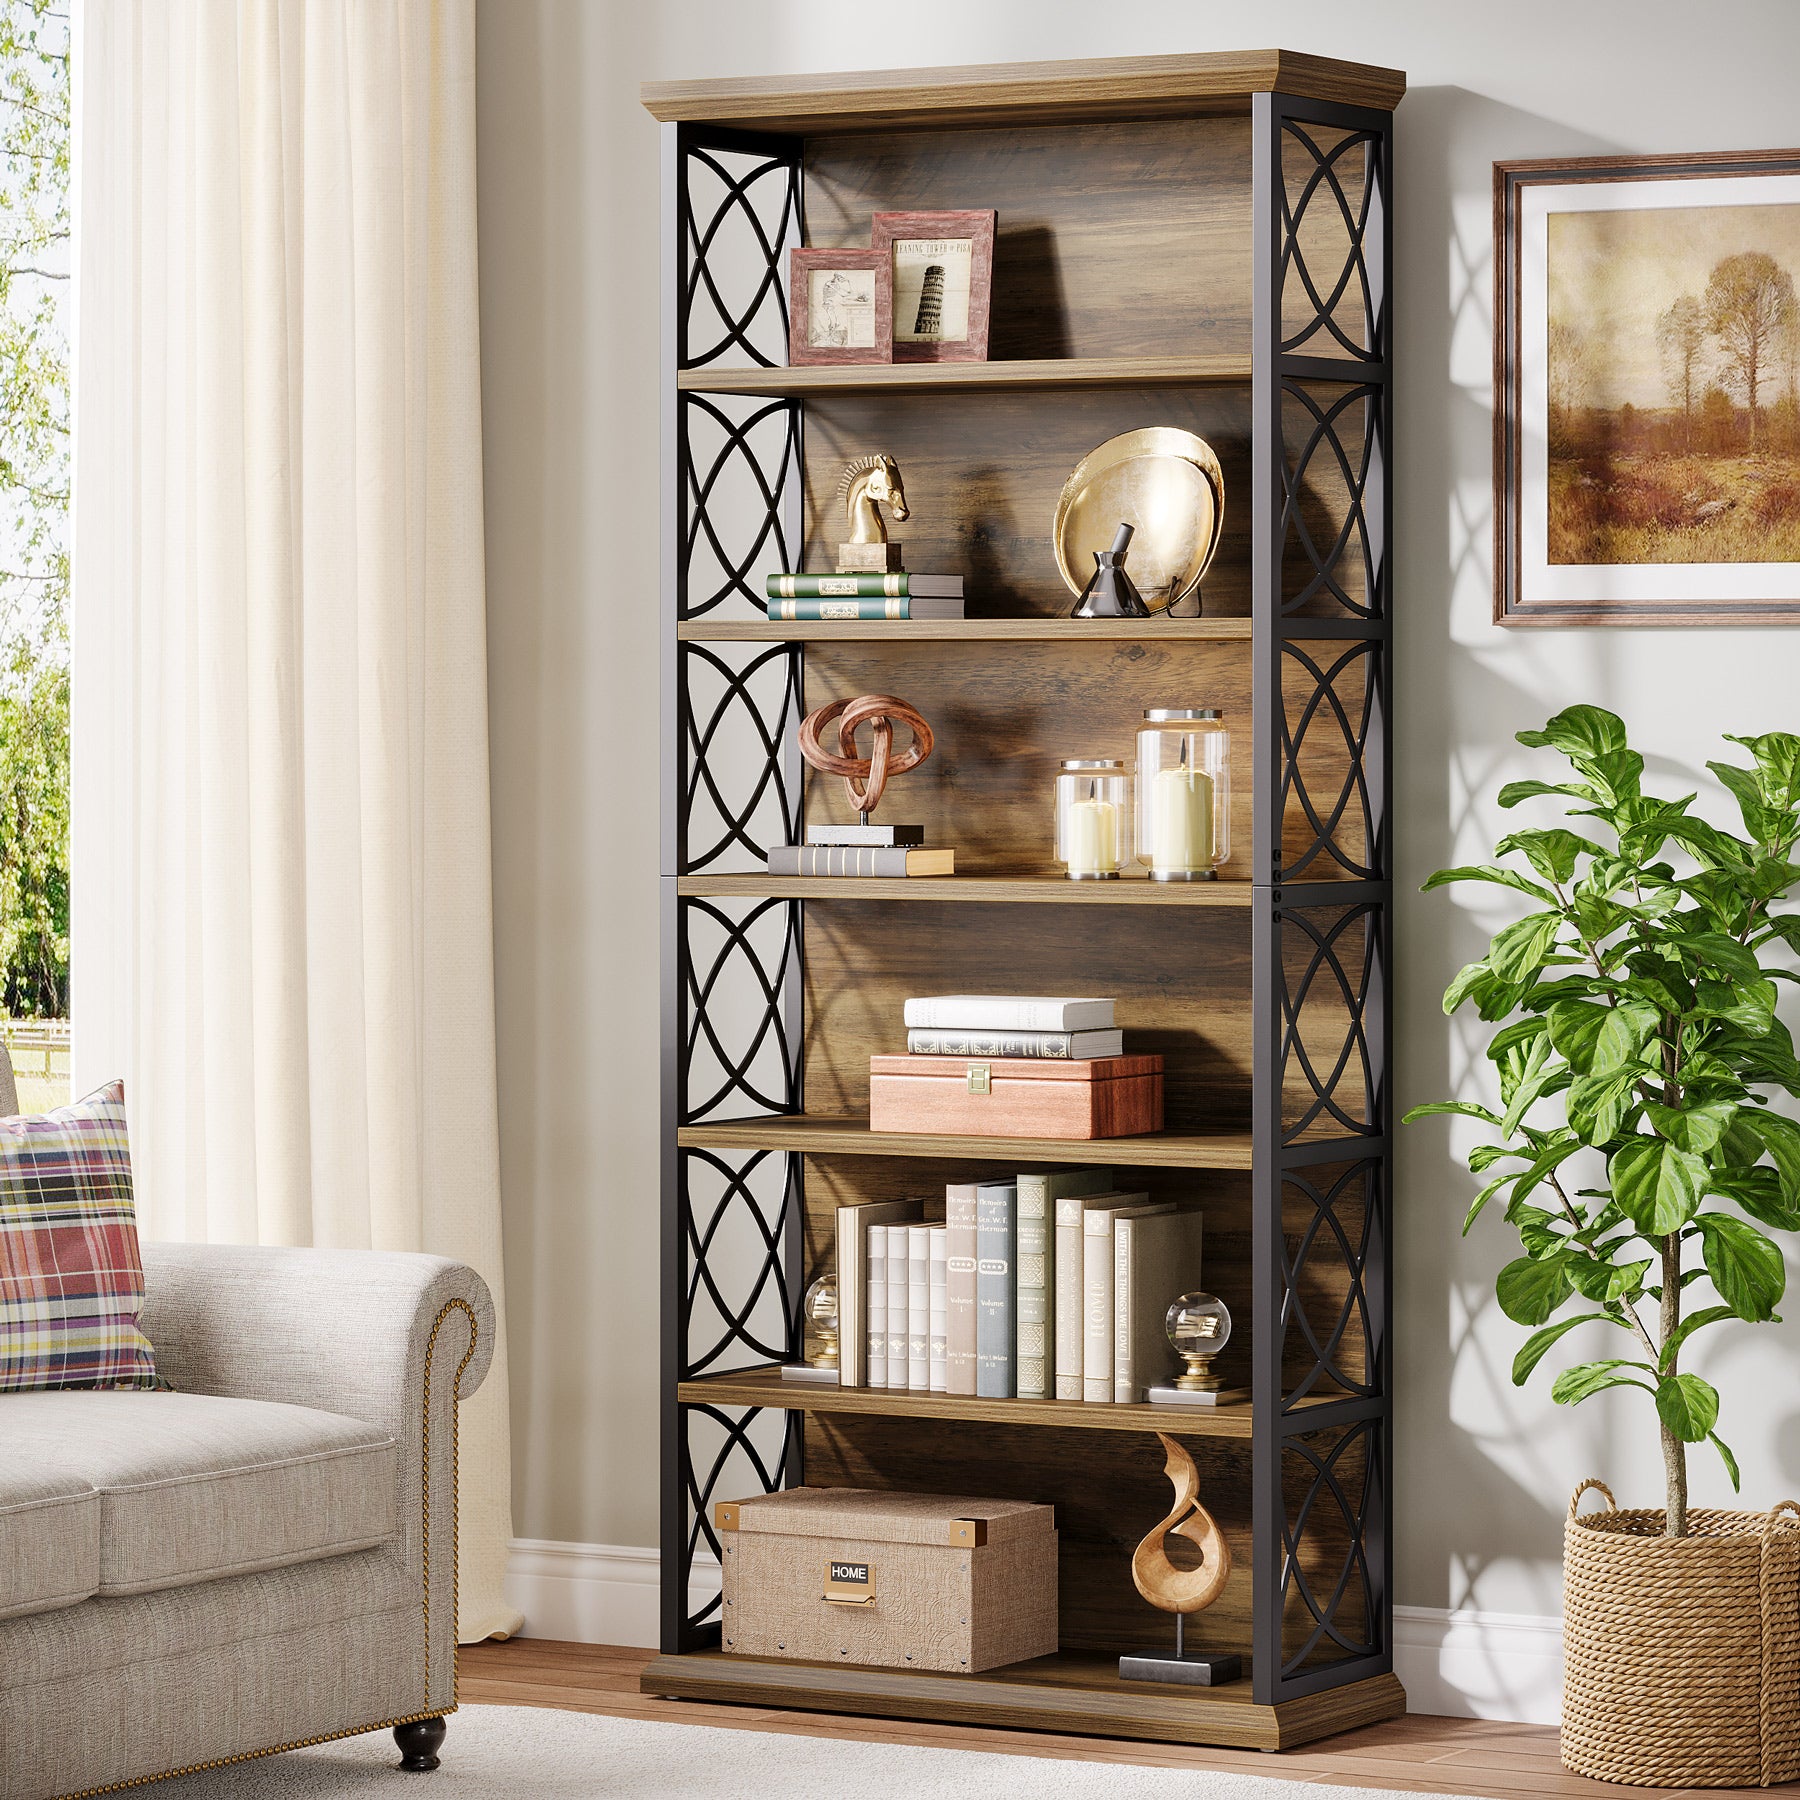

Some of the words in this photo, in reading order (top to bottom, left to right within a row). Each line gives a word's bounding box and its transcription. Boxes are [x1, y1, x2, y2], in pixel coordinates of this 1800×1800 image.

[926, 243, 948, 253] TOWER
[956, 243, 971, 253] PISA
[979, 1224, 1008, 1233] Sherman
[1119, 1231, 1128, 1256] WITH
[1119, 1258, 1128, 1276] THE
[950, 1296, 974, 1304] Volume
[1119, 1278, 1128, 1312] THINGS
[981, 1299, 1004, 1307] Volume
[1089, 1280, 1105, 1338] HOME
[1119, 1314, 1128, 1329] WE
[1119, 1330, 1128, 1354] LOVE
[832, 1566, 866, 1579] HOME
